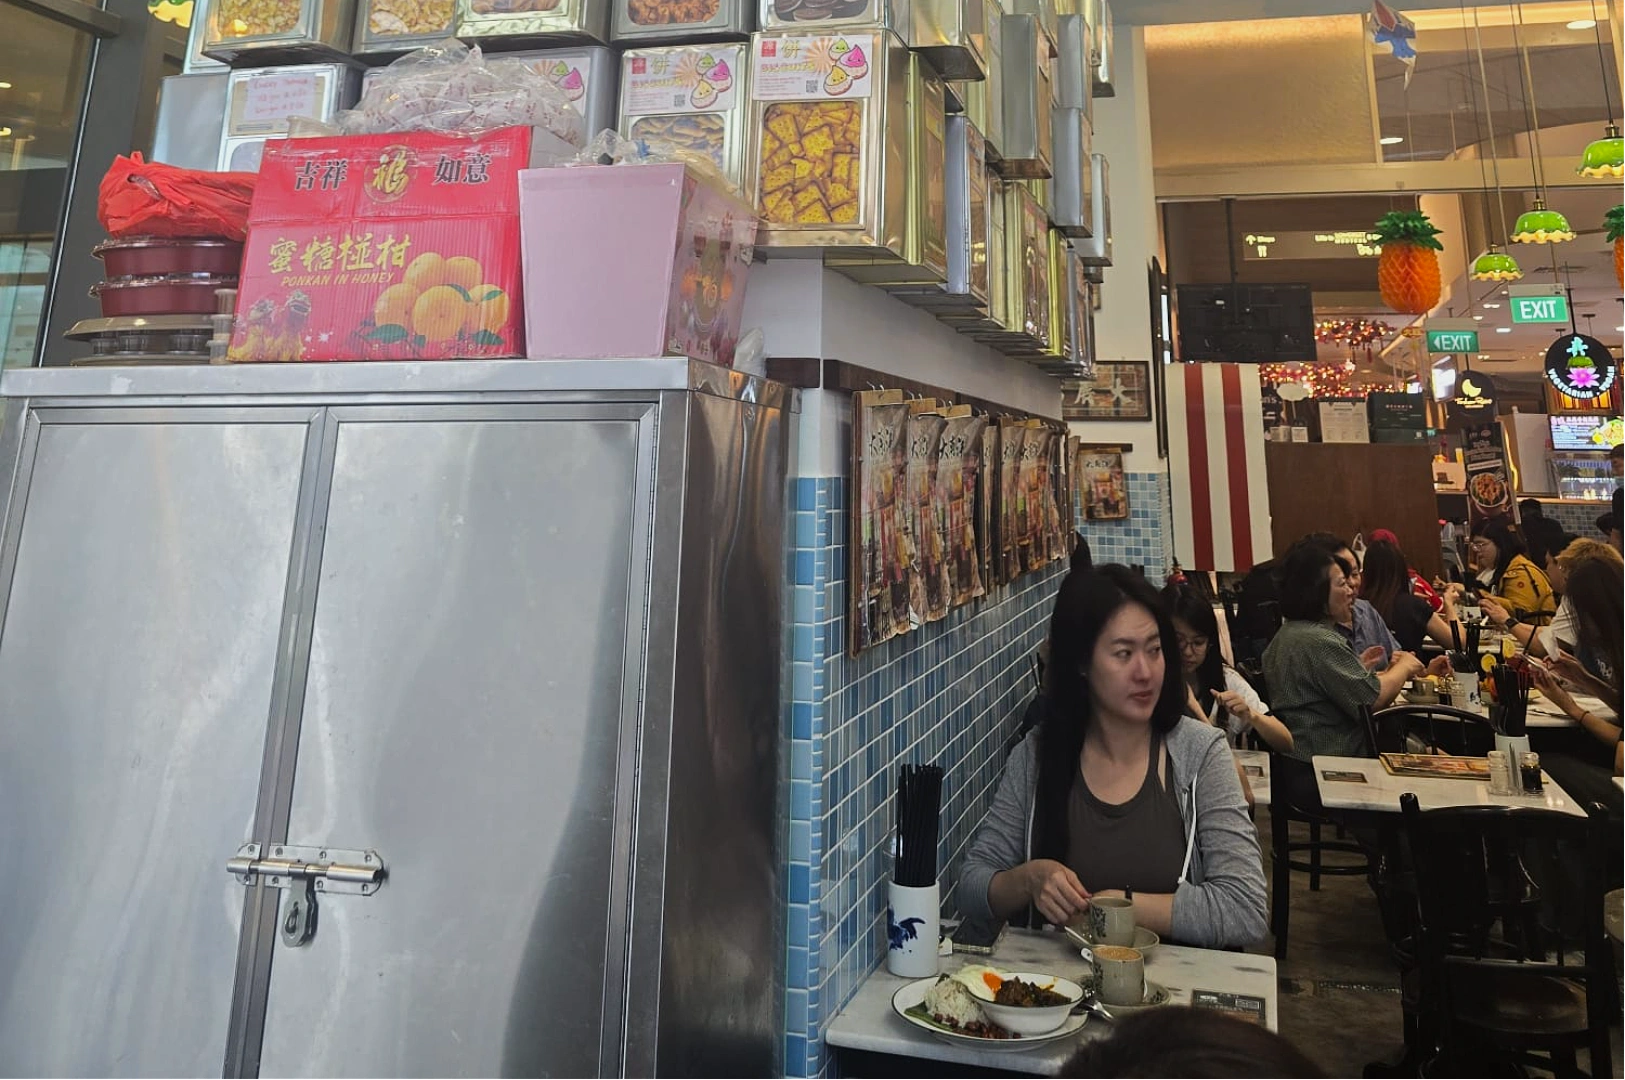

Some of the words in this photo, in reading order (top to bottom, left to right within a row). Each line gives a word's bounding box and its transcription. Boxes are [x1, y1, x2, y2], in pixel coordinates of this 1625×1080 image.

[295, 159, 348, 191] 吉祥
[433, 153, 492, 186] 如意
[268, 232, 411, 275] 蜜糖椪柑
[280, 274, 331, 288] PONKAN
[333, 273, 346, 285] IN
[347, 271, 395, 285] HONEY
[1519, 299, 1557, 319] EXIT
[1440, 335, 1472, 351] EXIT
